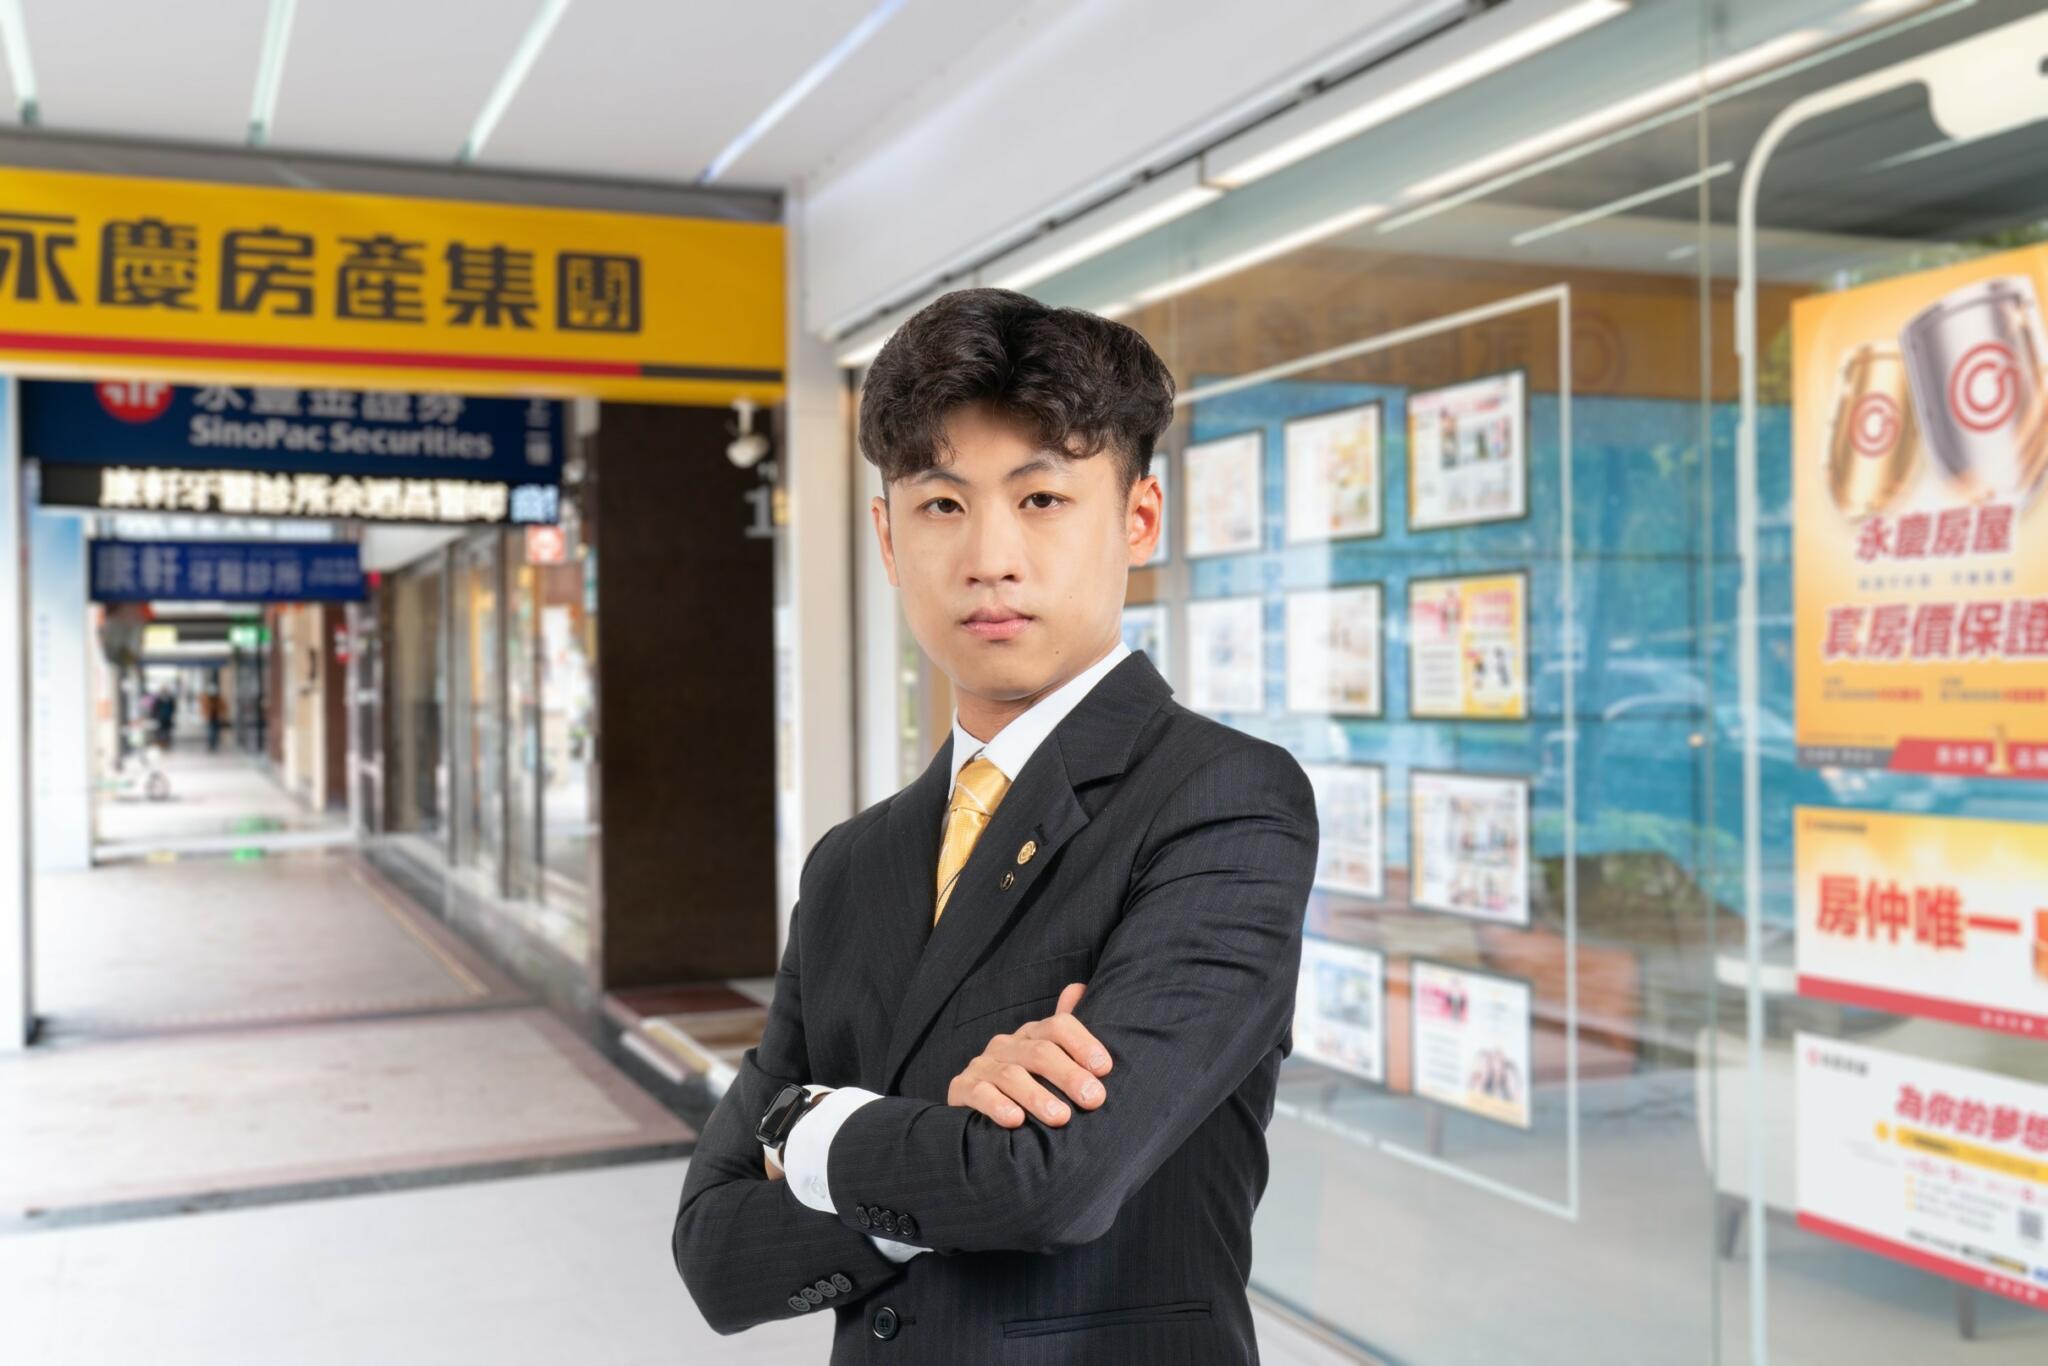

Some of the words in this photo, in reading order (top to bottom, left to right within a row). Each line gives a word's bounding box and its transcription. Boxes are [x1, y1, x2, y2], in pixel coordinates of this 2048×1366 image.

[0, 211, 643, 334] 永慶房產集團
[188, 412, 326, 452] SinoPac
[329, 420, 494, 460] Securities
[1856, 505, 2013, 562] 永慶房屋
[1816, 873, 2021, 953] 房仲唯一
